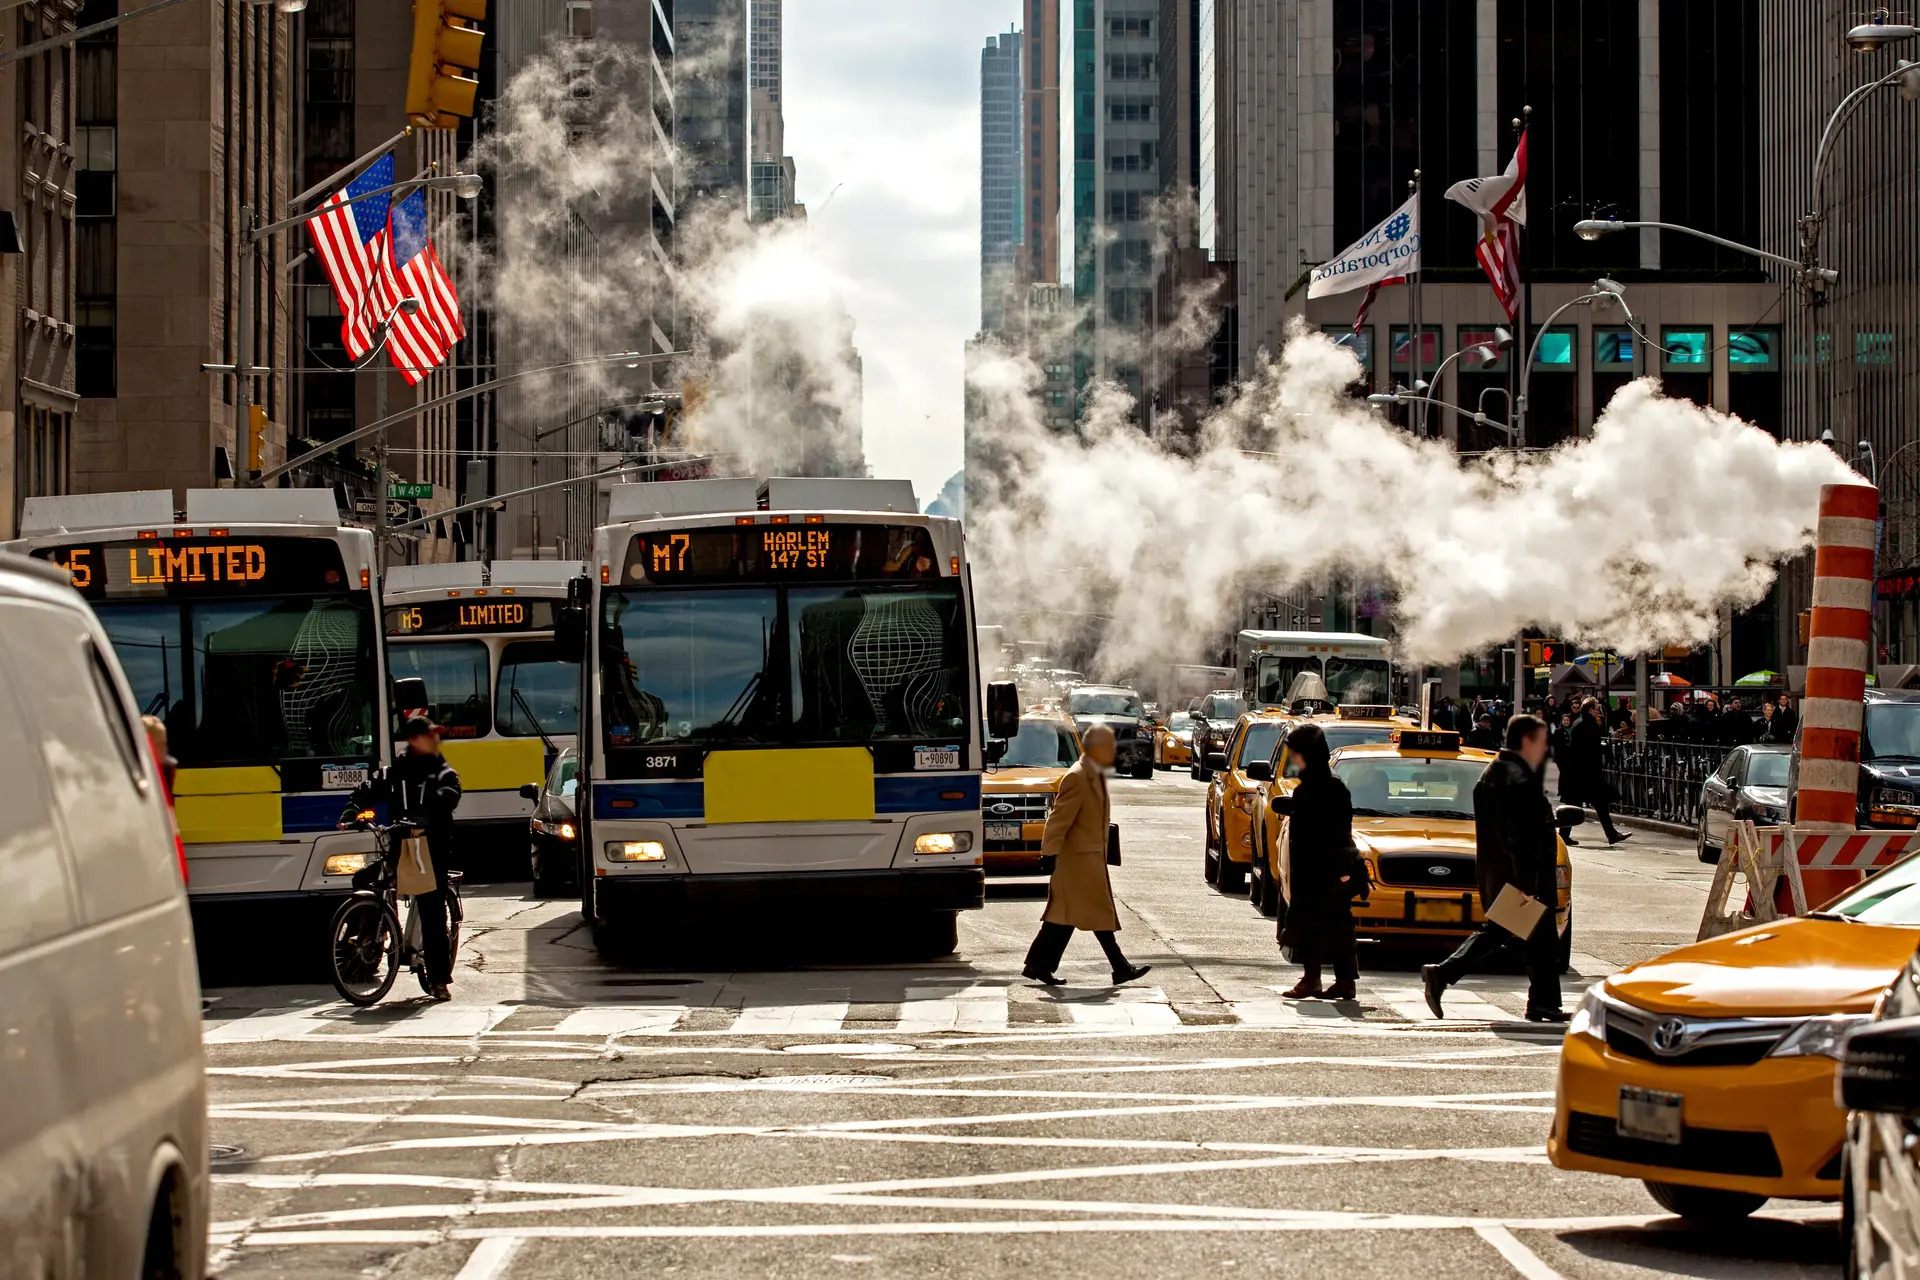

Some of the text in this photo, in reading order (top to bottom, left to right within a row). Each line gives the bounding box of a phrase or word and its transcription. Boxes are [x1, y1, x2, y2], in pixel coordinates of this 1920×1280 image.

[398, 486, 406, 496] W
[408, 486, 421, 497] 49
[764, 531, 829, 551] HARLEM
[653, 534, 690, 571] M7
[770, 550, 827, 568] 147 ST
[130, 545, 266, 584] LIMITED
[402, 604, 523, 629] M5 LIMITED
[1417, 734, 1442, 745] 9A34
[646, 756, 677, 768] 3871
